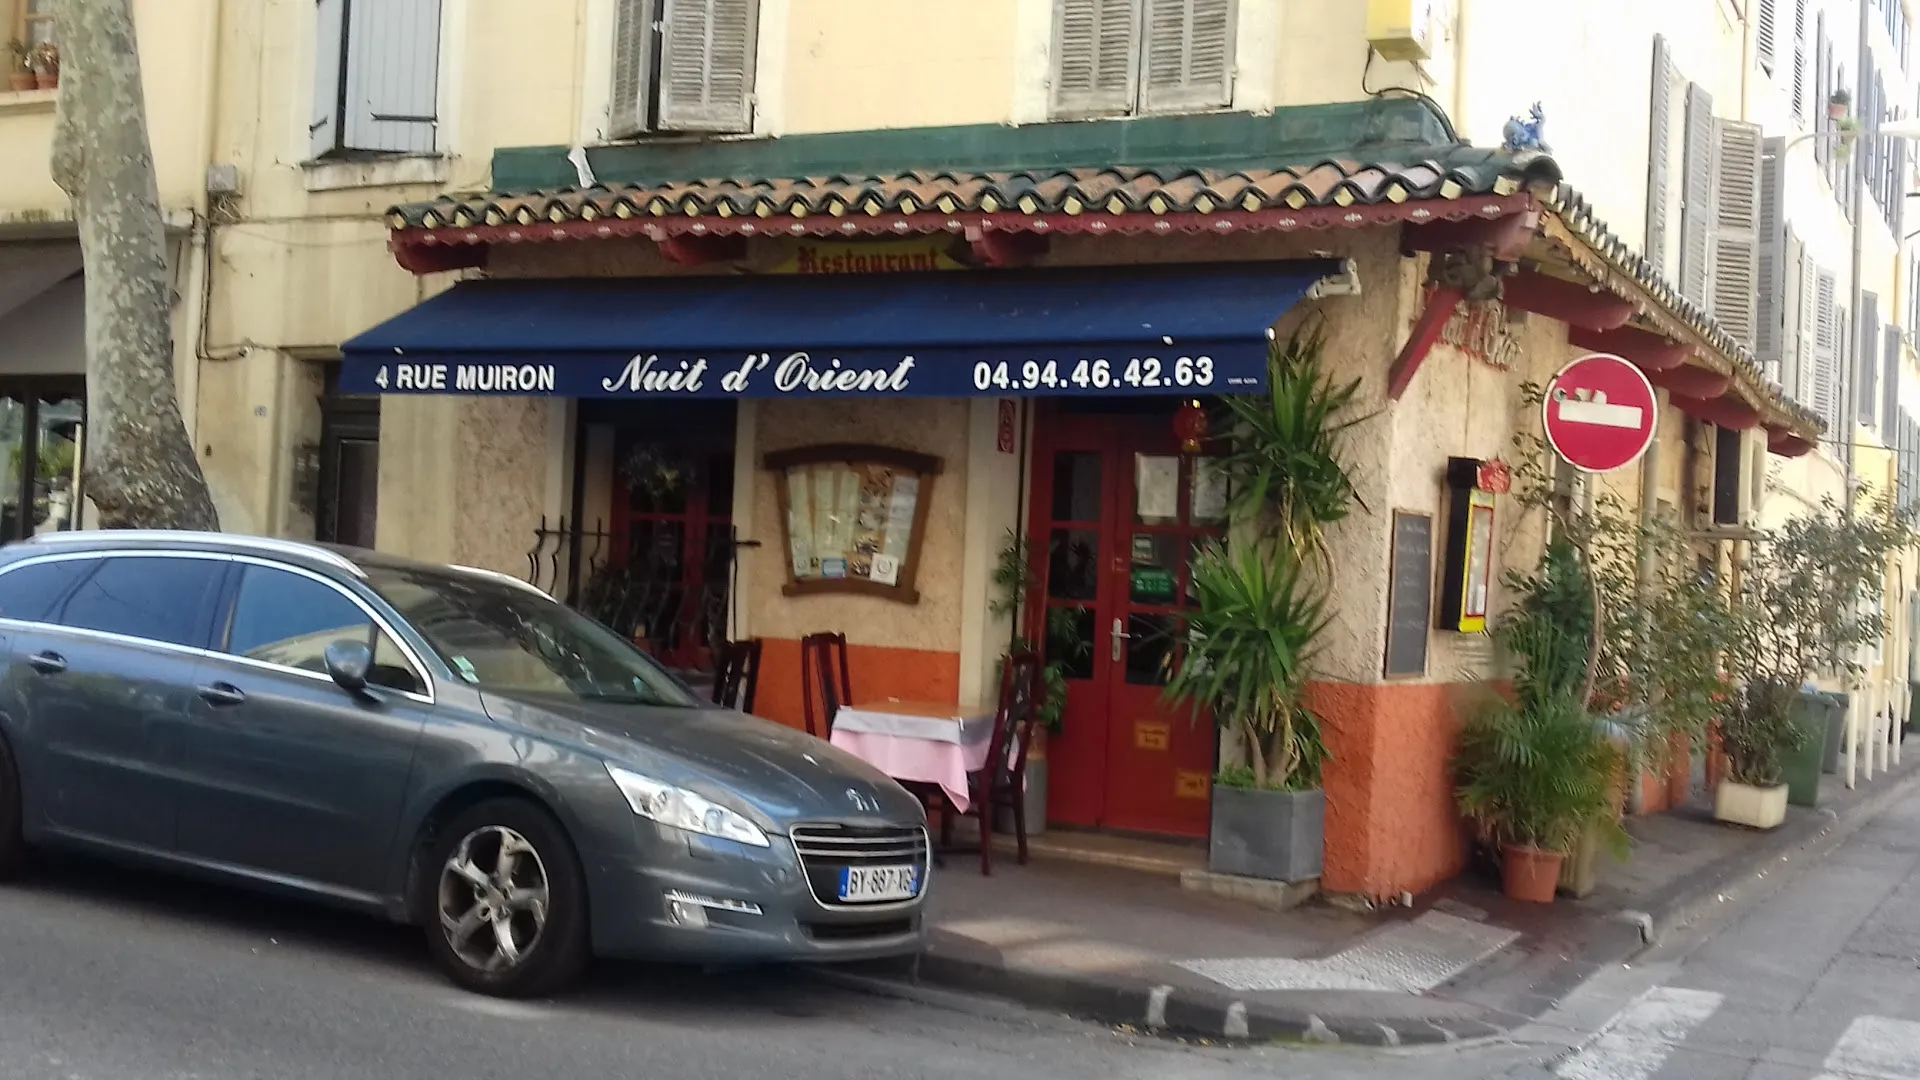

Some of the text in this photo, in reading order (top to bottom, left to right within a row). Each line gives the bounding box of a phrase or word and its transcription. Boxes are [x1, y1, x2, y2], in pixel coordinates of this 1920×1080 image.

[797, 245, 940, 274] Restaurant
[375, 364, 555, 391] 4 RUE MUIRON
[602, 353, 708, 392] Nuit
[973, 356, 1214, 391] 04.94.46.42.63
